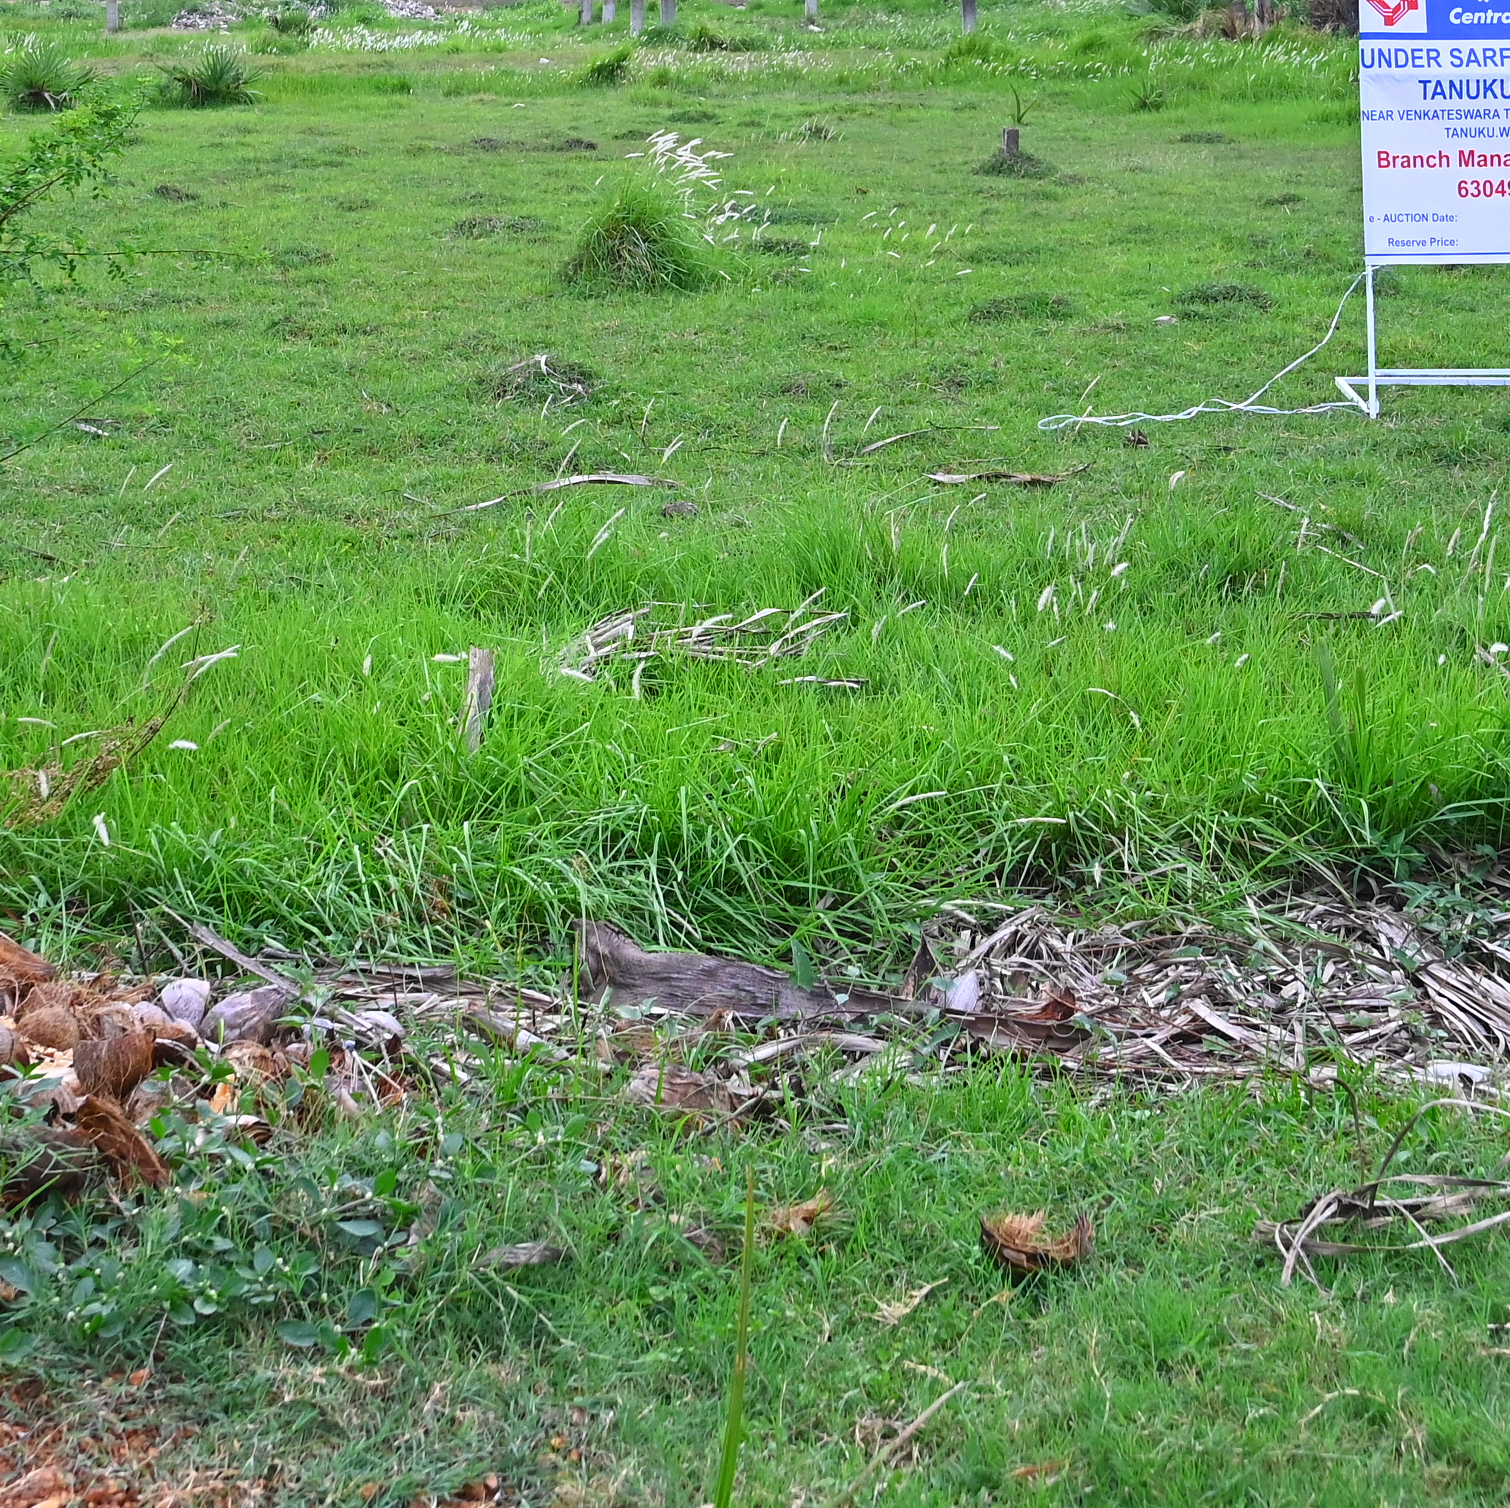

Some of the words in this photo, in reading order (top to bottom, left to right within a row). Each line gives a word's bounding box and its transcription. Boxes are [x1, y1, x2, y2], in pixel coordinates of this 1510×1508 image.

[1360, 48, 1441, 69] UNDER
[1362, 110, 1394, 121] NEAR
[1397, 108, 1500, 121] VENKATESWARA
[1377, 150, 1451, 169] Branch
[1383, 213, 1429, 223] AUCTION
[1432, 213, 1458, 223] Date:
[1388, 237, 1427, 247] Reserve
[1430, 237, 1459, 247] Price:
